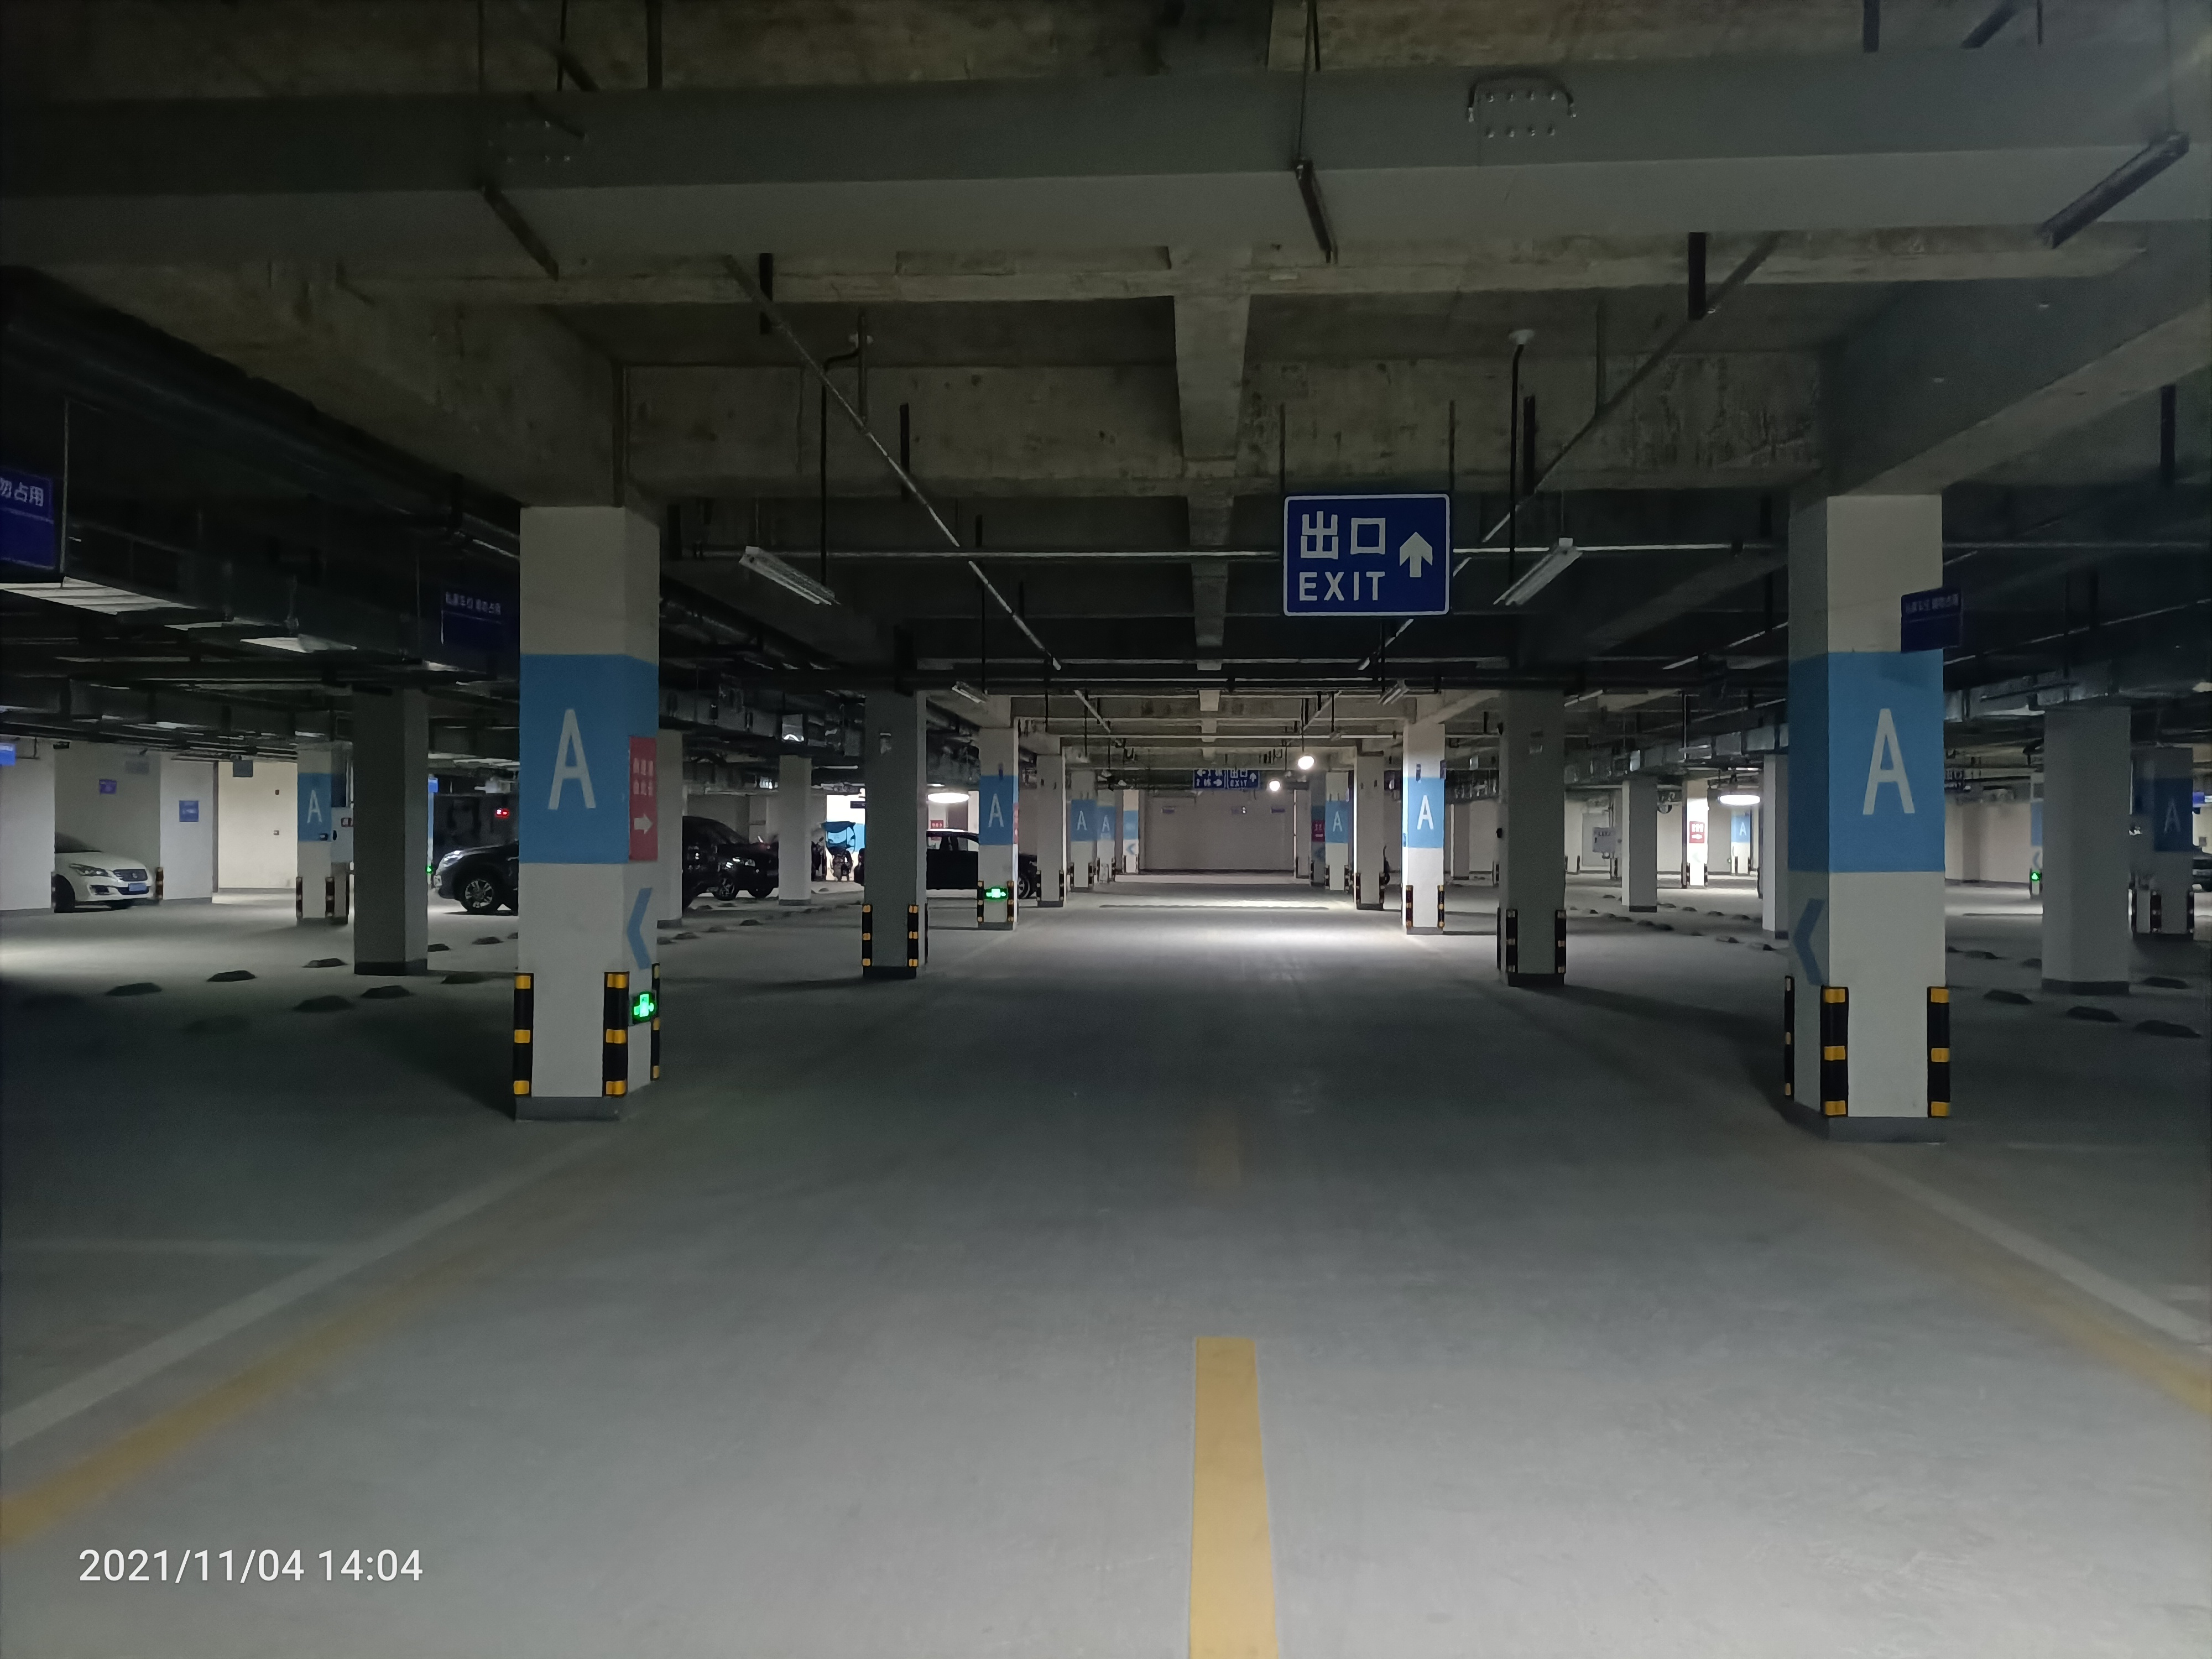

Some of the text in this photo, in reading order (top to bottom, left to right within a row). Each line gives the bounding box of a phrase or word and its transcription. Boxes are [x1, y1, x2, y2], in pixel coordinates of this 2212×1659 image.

[1300, 510, 1386, 560] 出口
[1299, 571, 1385, 601] EXIT
[547, 708, 596, 810] A
[1863, 708, 1915, 815] A
[307, 789, 322, 823] A
[988, 793, 1005, 828] A
[1077, 810, 1087, 831] A
[1332, 811, 1343, 832] A
[1417, 795, 1434, 830] A
[2164, 800, 2181, 834] A
[1102, 815, 1110, 832] A
[1739, 822, 1747, 836] A
